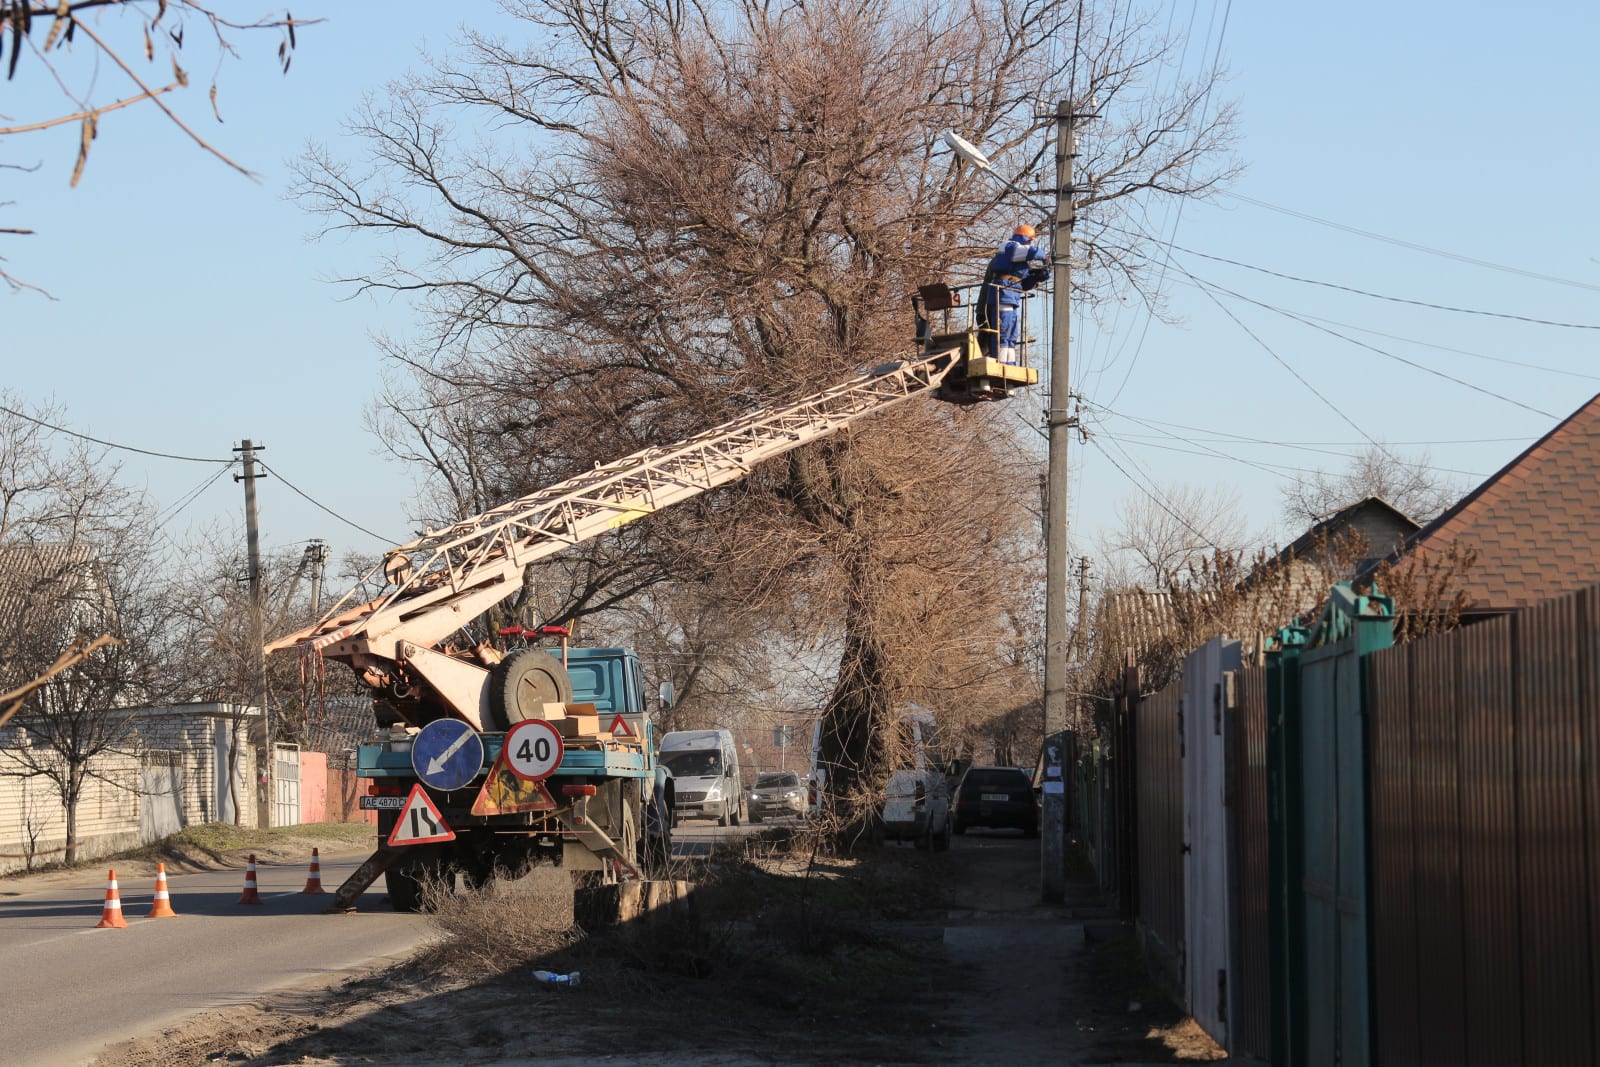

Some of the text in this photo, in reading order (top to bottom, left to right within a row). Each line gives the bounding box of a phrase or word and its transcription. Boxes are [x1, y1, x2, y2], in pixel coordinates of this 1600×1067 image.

[516, 737, 551, 763] 40
[366, 798, 377, 807] AE
[378, 798, 398, 807] 4870
